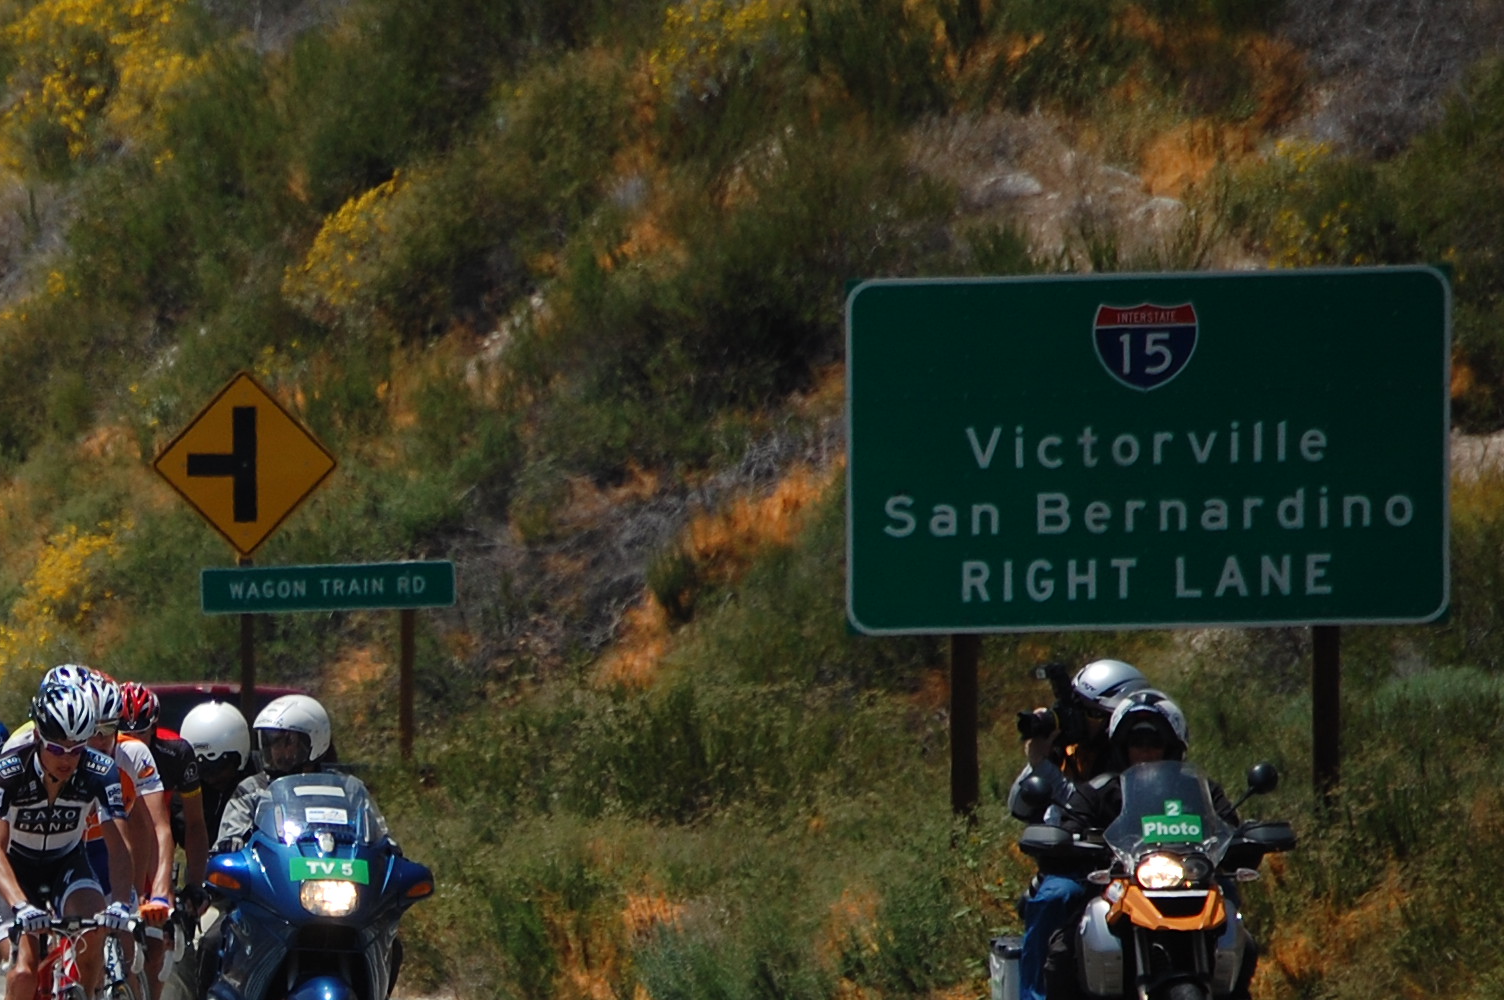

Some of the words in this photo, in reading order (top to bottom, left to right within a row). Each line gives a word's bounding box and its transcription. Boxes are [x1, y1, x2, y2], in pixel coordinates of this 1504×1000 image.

[1117, 311, 1176, 324] INTERSTATE
[1119, 333, 1172, 375] 15
[965, 419, 1328, 469] Victorville
[883, 494, 999, 538] San
[1036, 486, 1414, 535] Bernardino
[962, 558, 1138, 602] RIGHT
[1176, 553, 1333, 599] LANE
[229, 580, 306, 600] WAGON
[320, 577, 384, 597] TRAIN
[397, 575, 426, 595] RD
[88, 751, 111, 765] SAXO
[23, 810, 76, 820] SAXO
[1167, 802, 1180, 816] 2
[19, 822, 76, 832] BANK
[1143, 821, 1200, 837] Photo
[306, 861, 335, 875] TV
[342, 862, 353, 876] 5
